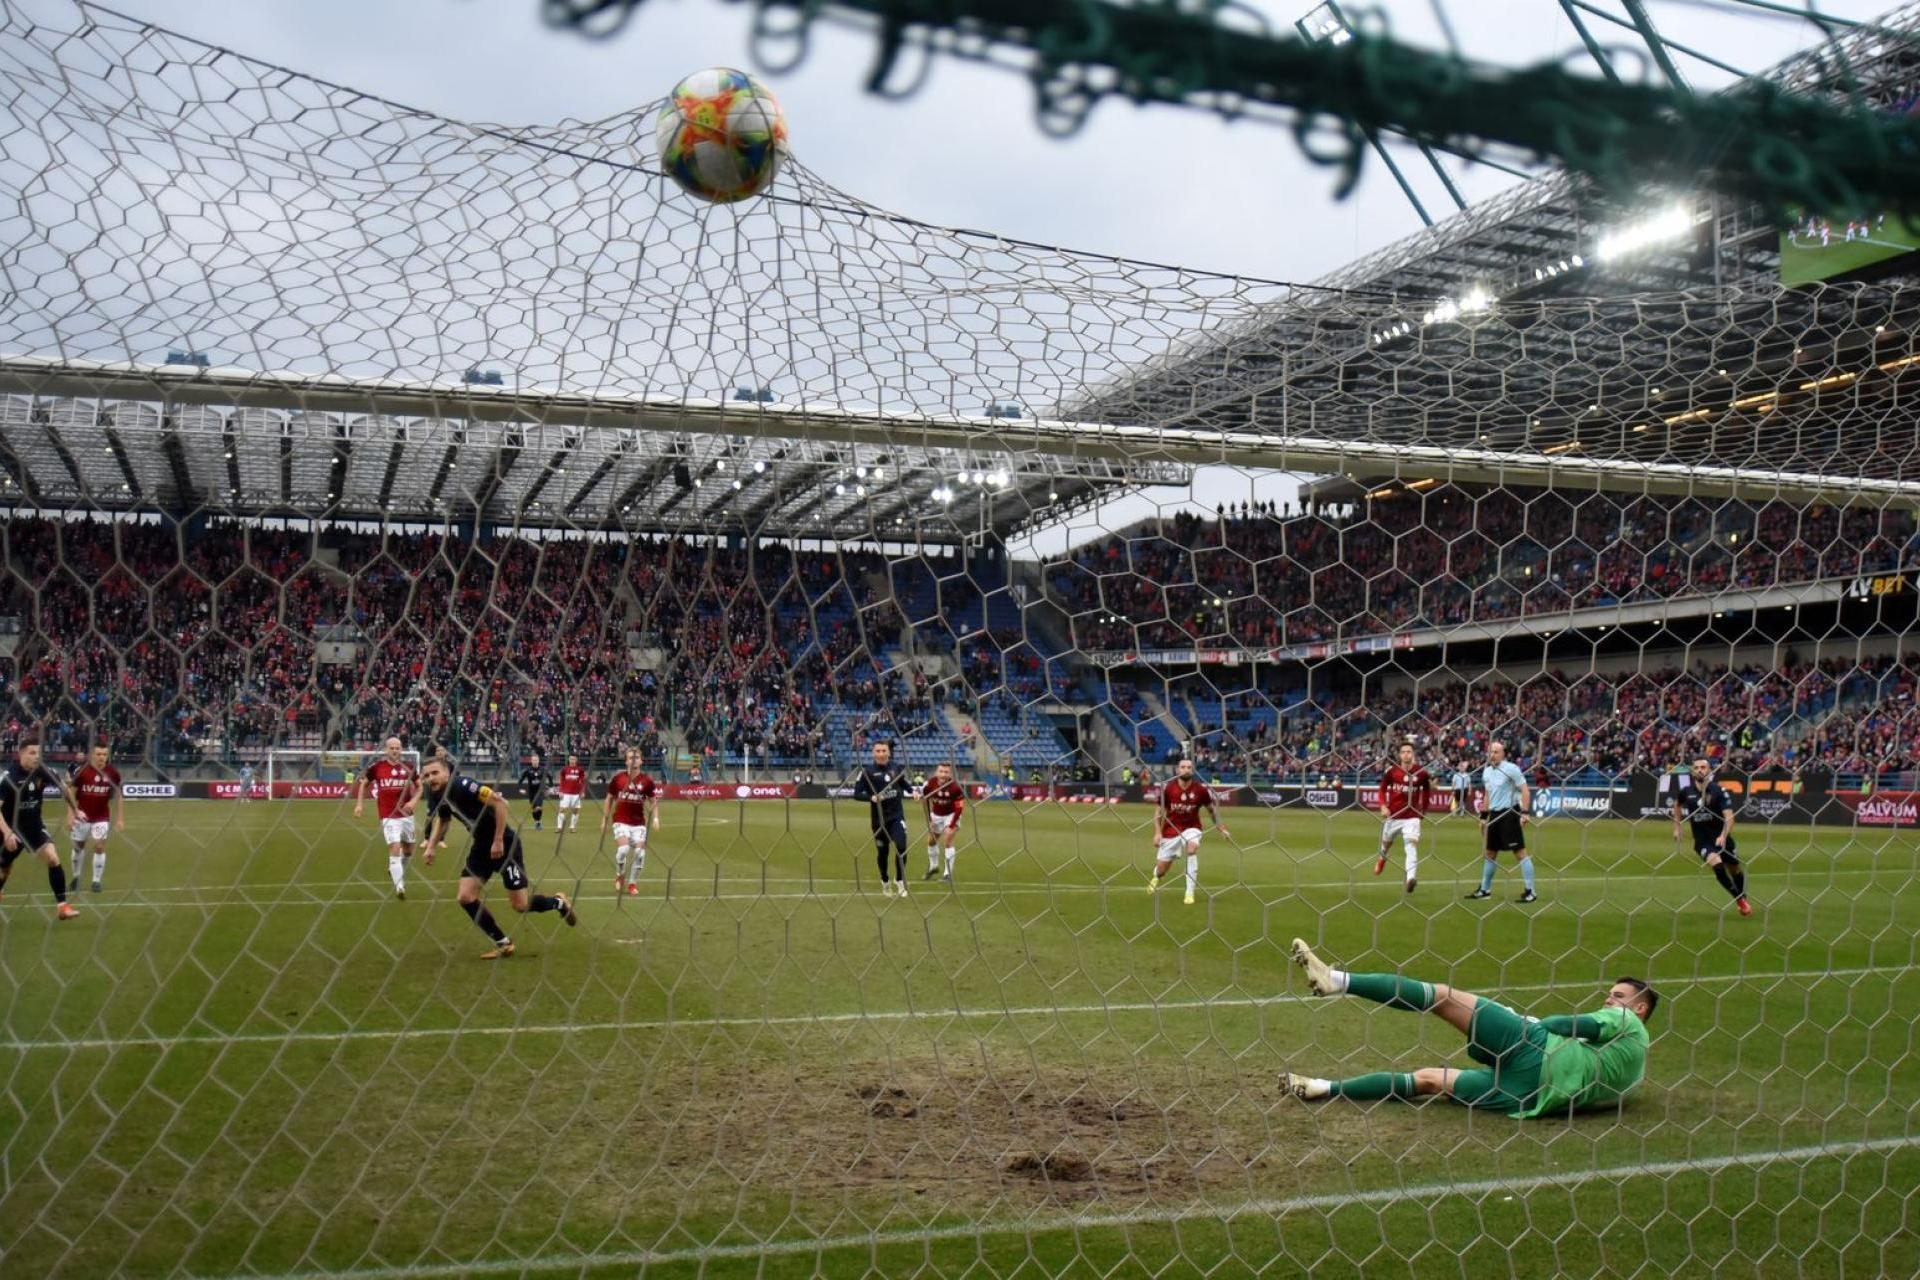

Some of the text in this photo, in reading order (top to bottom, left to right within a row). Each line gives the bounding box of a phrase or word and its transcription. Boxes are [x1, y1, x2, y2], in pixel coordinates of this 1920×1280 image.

[126, 785, 173, 795] OSHEE
[216, 784, 271, 793] DEMTEC
[753, 786, 782, 796] onet
[1309, 792, 1336, 803] OSHEE
[1858, 801, 1918, 818] SALVUM
[506, 865, 521, 881] 14
